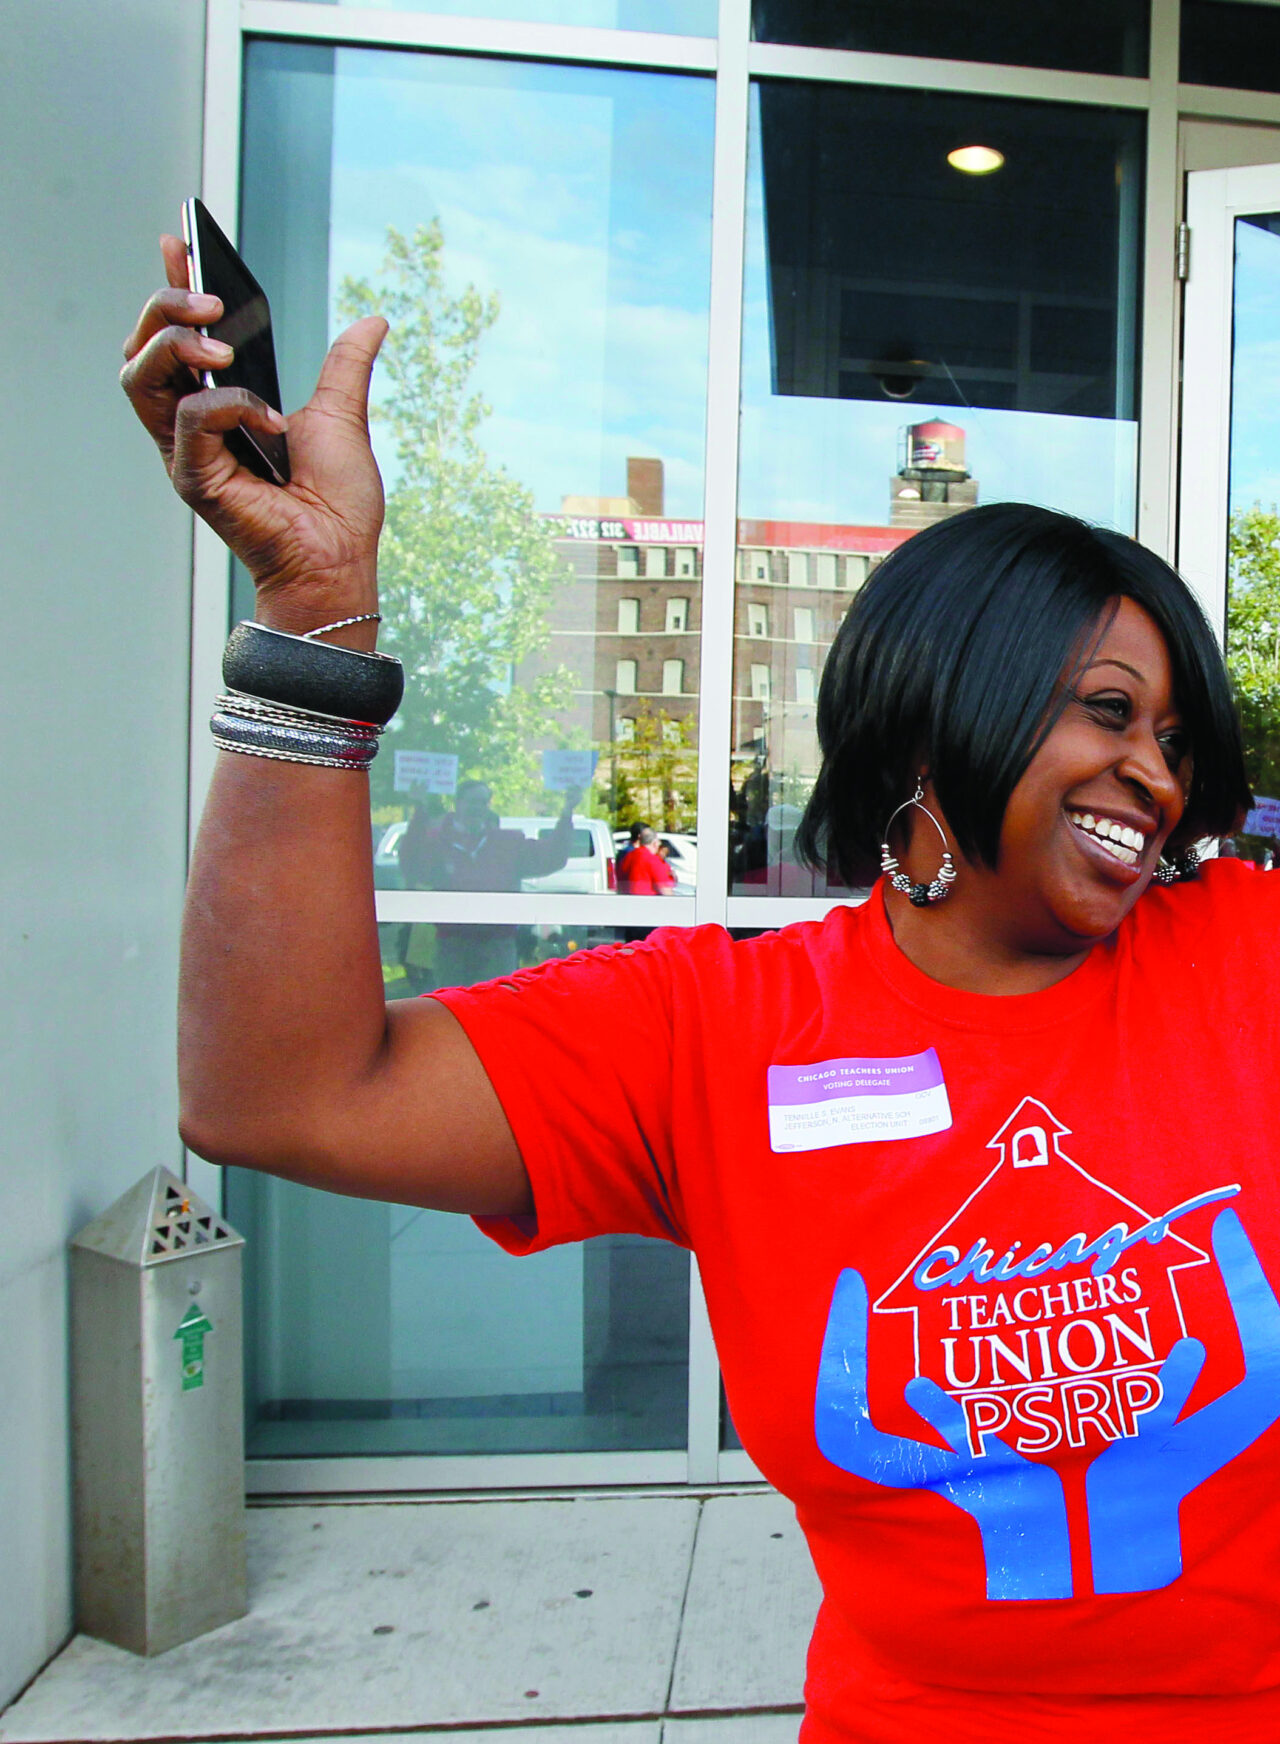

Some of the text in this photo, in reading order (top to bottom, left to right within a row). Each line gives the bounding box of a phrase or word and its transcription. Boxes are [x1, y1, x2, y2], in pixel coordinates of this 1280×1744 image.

[797, 1065, 914, 1083] CHICAGO TEACHERS UNION
[823, 1078, 891, 1091] VOTING DELEGATE
[783, 1112, 821, 1122] TENNILLE
[830, 1105, 856, 1116] EVANS
[842, 1111, 894, 1123] ALTERNATIVE
[851, 1121, 889, 1131] ELECTION
[913, 1184, 1242, 1292] Chicago
[942, 1267, 1143, 1331] TEACHERS
[940, 1306, 1156, 1389] UNION
[960, 1371, 1165, 1459] PSRP
